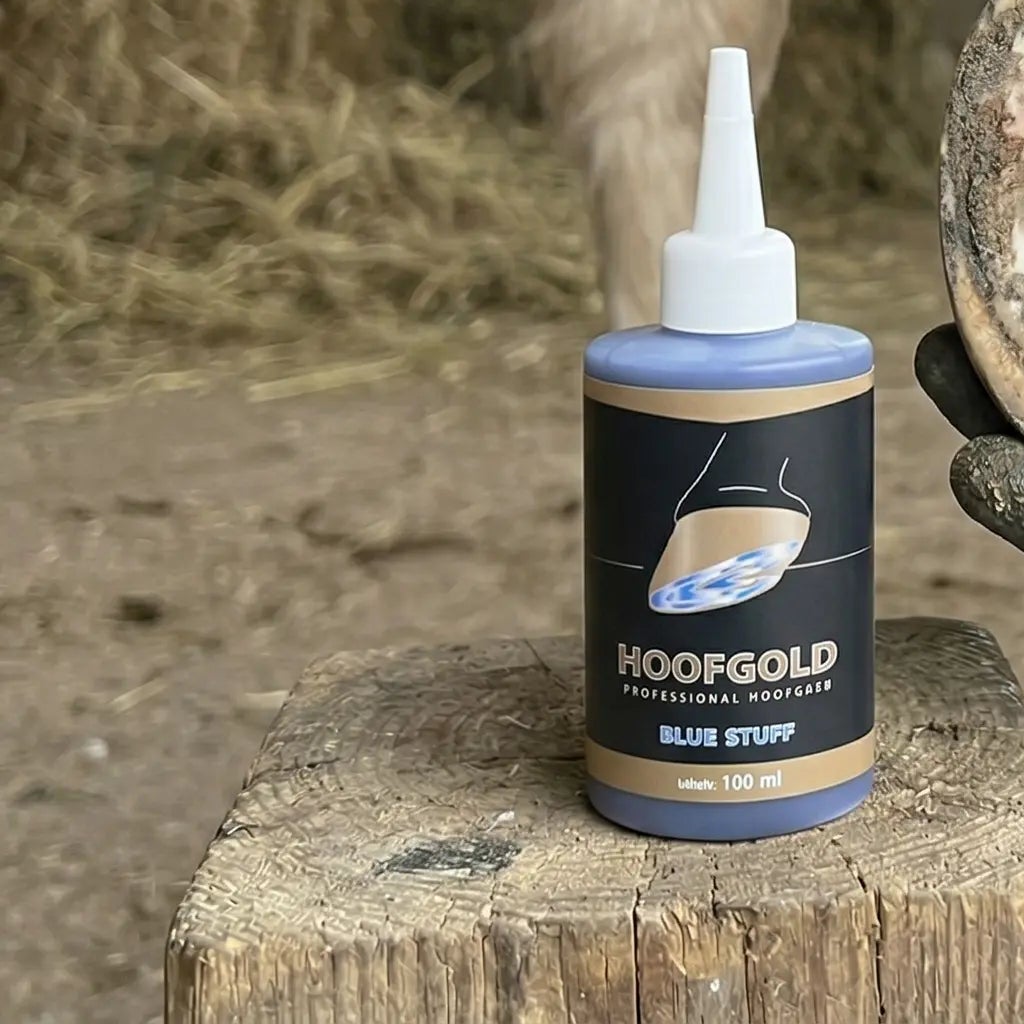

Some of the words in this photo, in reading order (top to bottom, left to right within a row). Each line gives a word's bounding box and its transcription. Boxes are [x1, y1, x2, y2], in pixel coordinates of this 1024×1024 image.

[617, 640, 839, 685] HOOFGOLD
[623, 683, 740, 704] PROFESSIONAL
[659, 725, 718, 747] BLUE
[724, 722, 796, 747] STUFF
[722, 773, 754, 791] 100
[760, 769, 783, 789] ml
